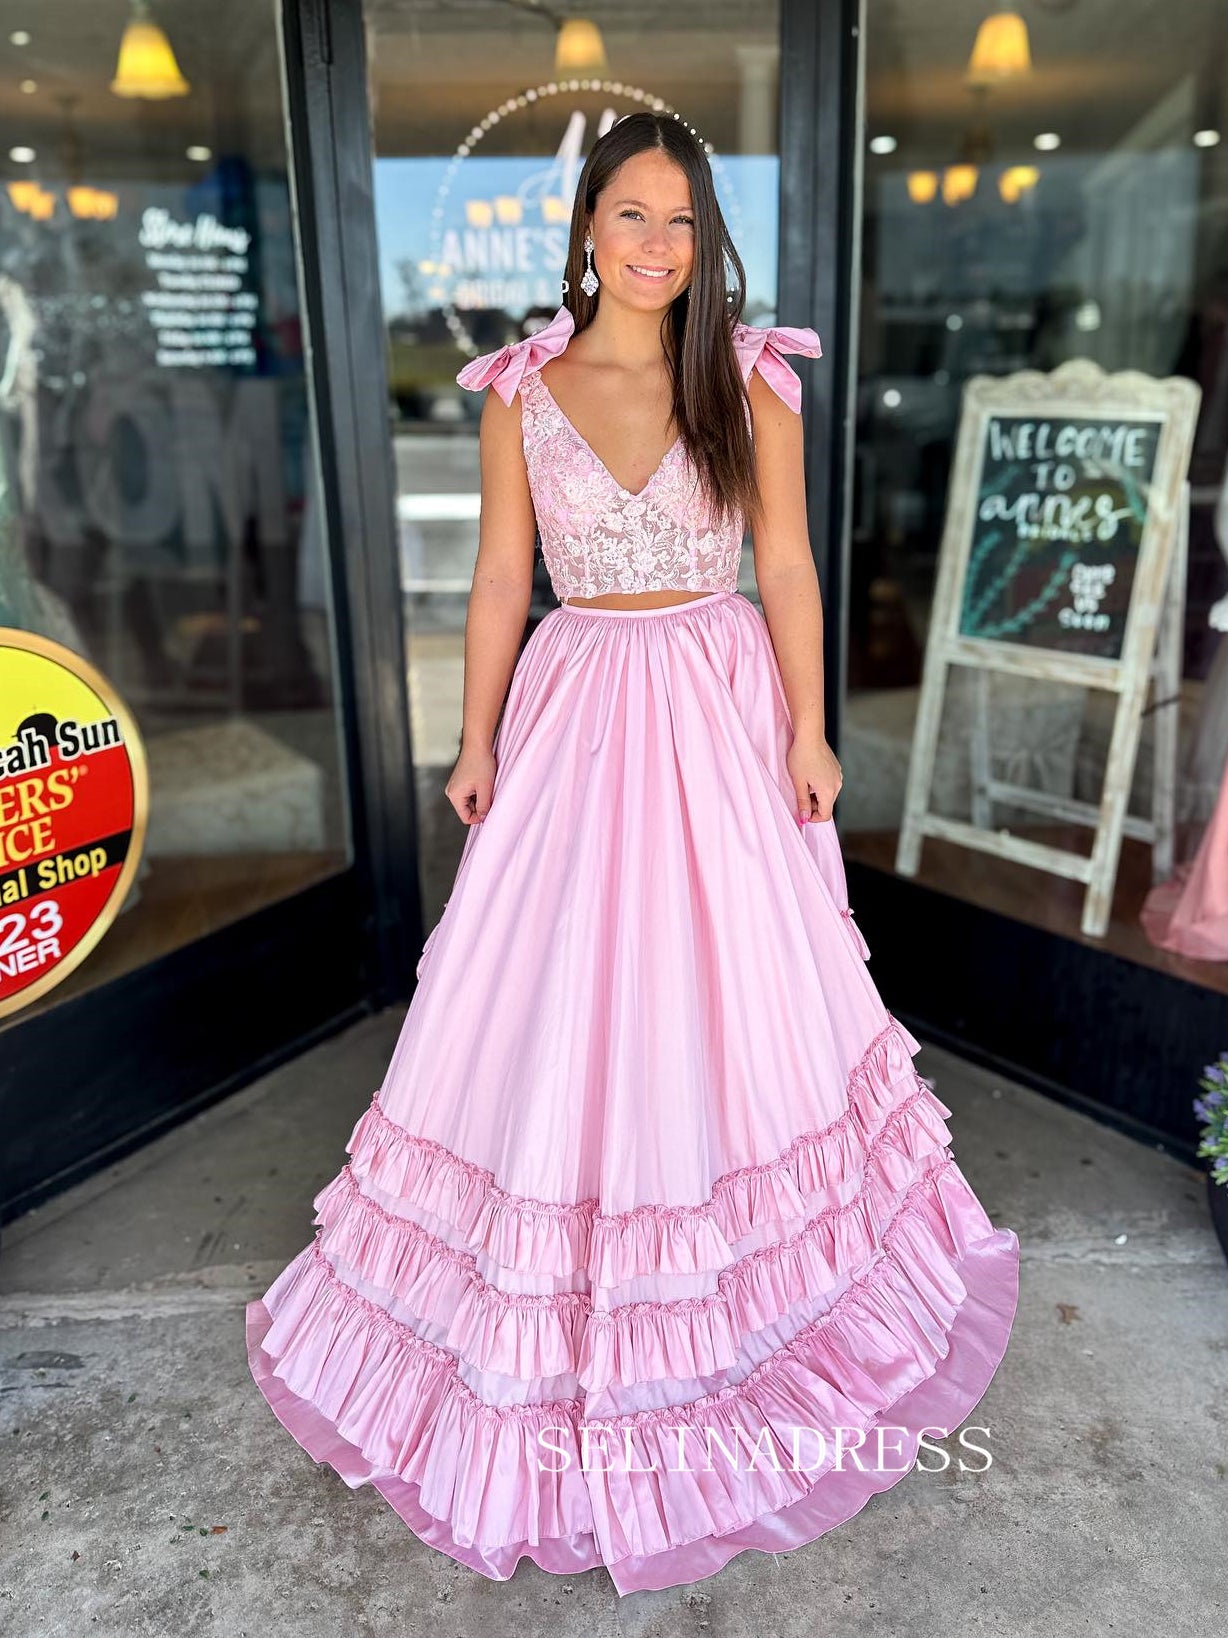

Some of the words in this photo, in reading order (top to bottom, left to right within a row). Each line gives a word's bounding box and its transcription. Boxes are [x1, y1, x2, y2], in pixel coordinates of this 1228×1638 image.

[990, 420, 1147, 467] WELCOME
[1030, 460, 1077, 491] TO
[59, 719, 120, 757] Sun
[37, 847, 107, 878] Shop
